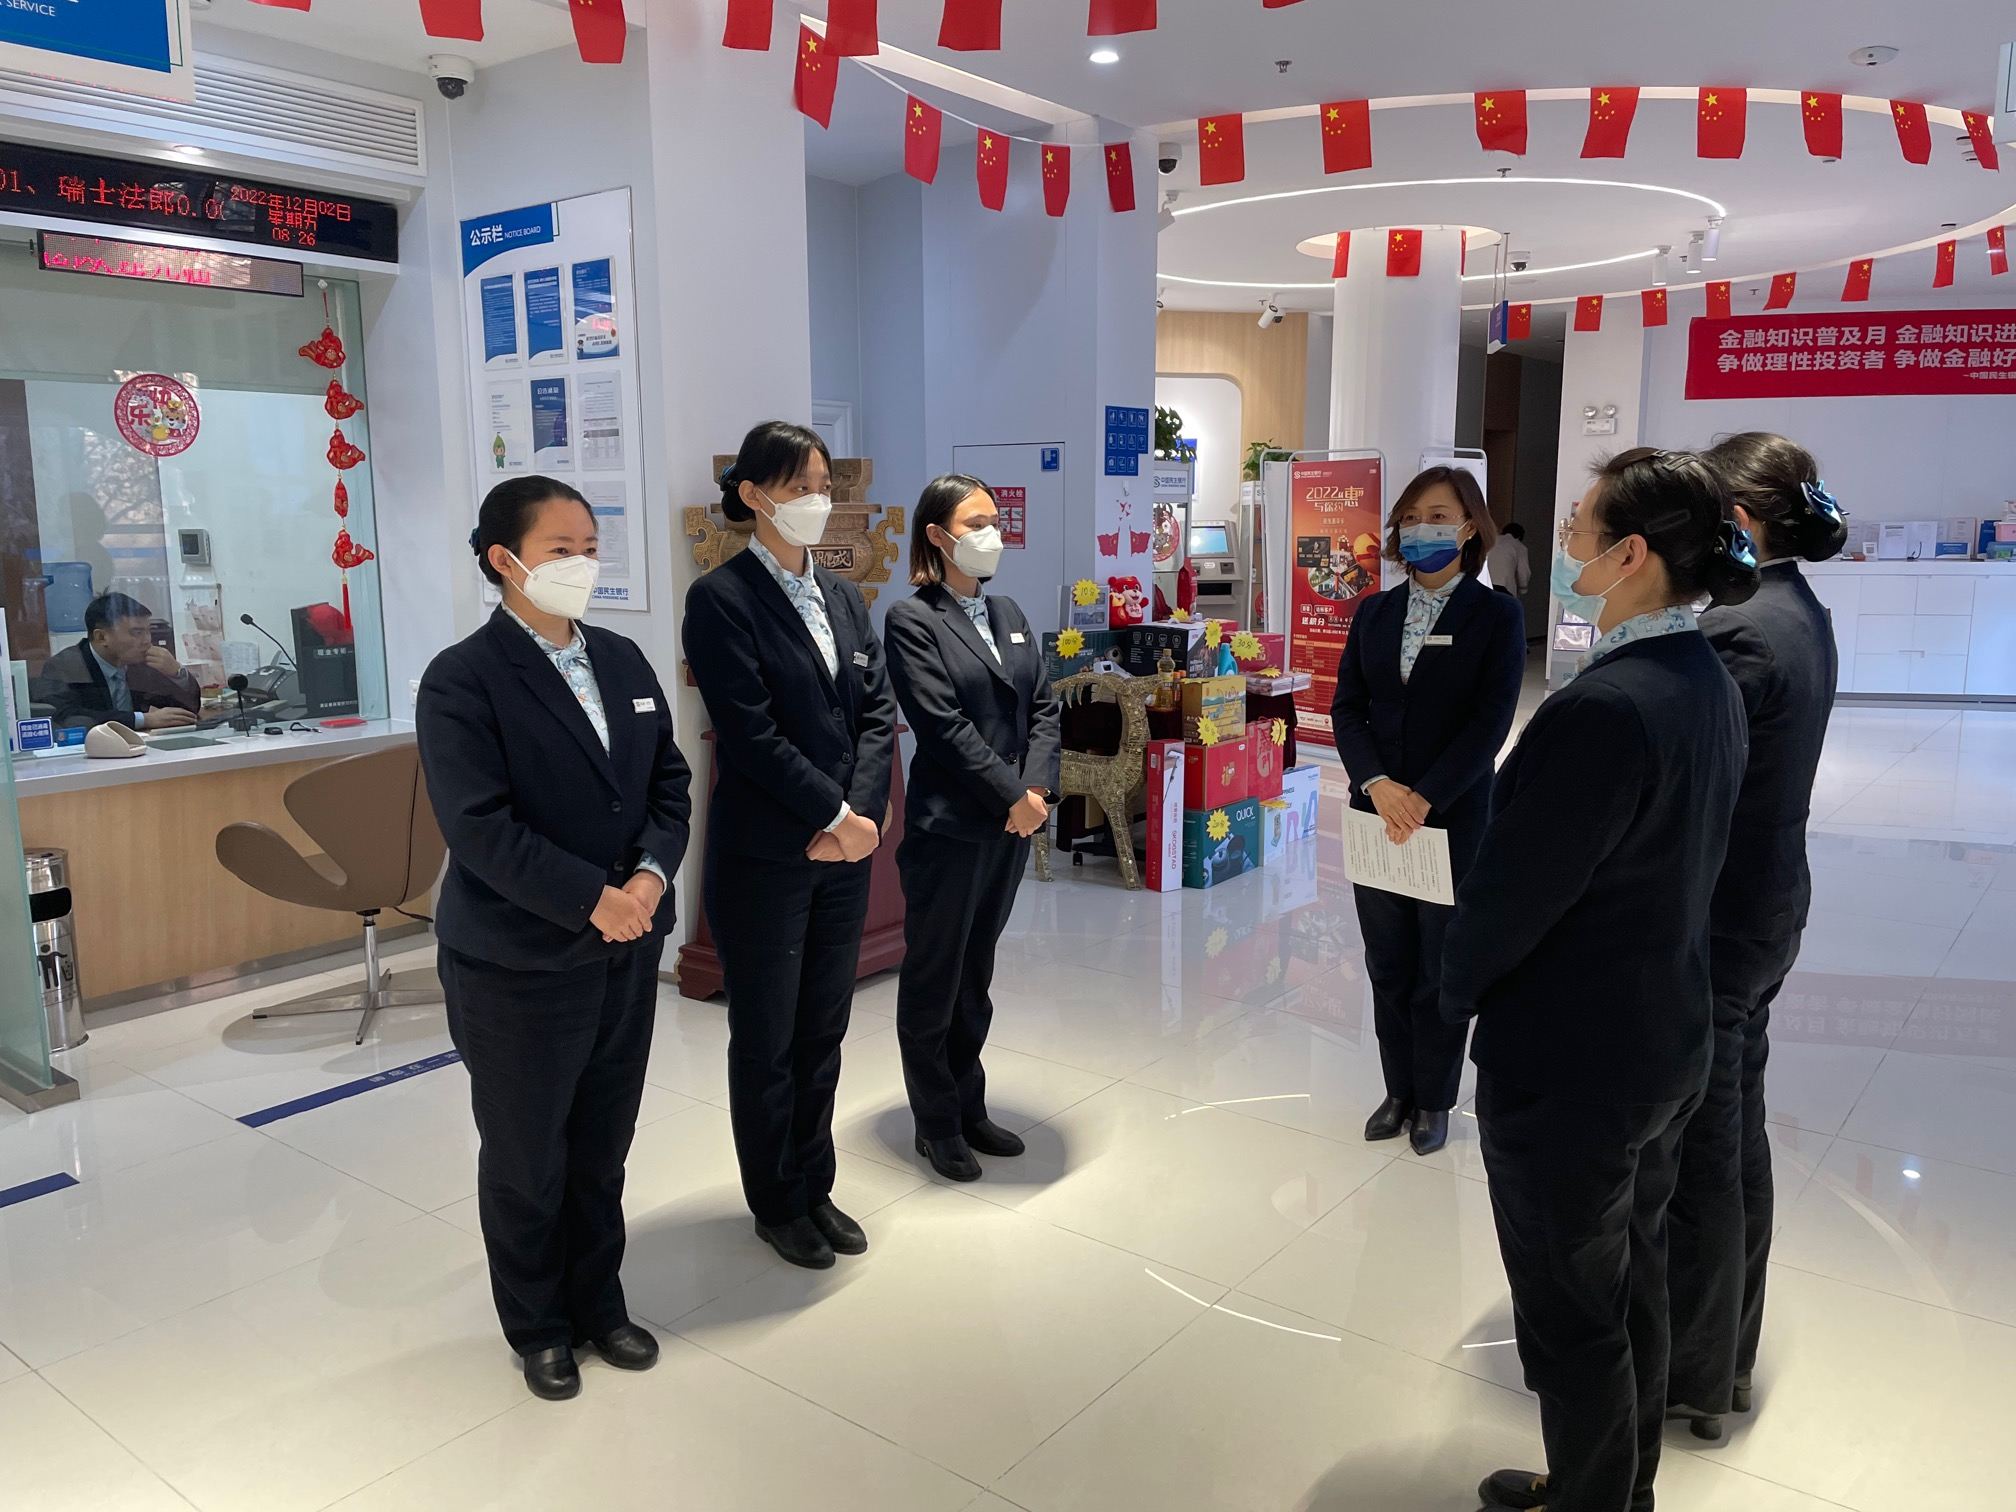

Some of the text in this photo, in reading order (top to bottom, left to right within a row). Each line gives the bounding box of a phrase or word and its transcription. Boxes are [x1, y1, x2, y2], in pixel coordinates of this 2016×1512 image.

[6, 0, 56, 17] SERVICE
[230, 184, 351, 222] 2022年12月02日
[268, 208, 317, 232] 星期五
[272, 227, 316, 247] 08:26
[470, 224, 541, 246] 公示栏 NOTICE BOARD
[1718, 323, 2016, 349] 金融知识普及月 金融知识进
[1716, 347, 2016, 373] 争做理性投资者 争做金融好
[1001, 489, 1024, 498] 消火栓
[1313, 501, 1344, 513] 与你约
[1302, 616, 1325, 626] 送积分
[1236, 638, 1253, 650] 30分
[1235, 805, 1254, 822] QUICK
